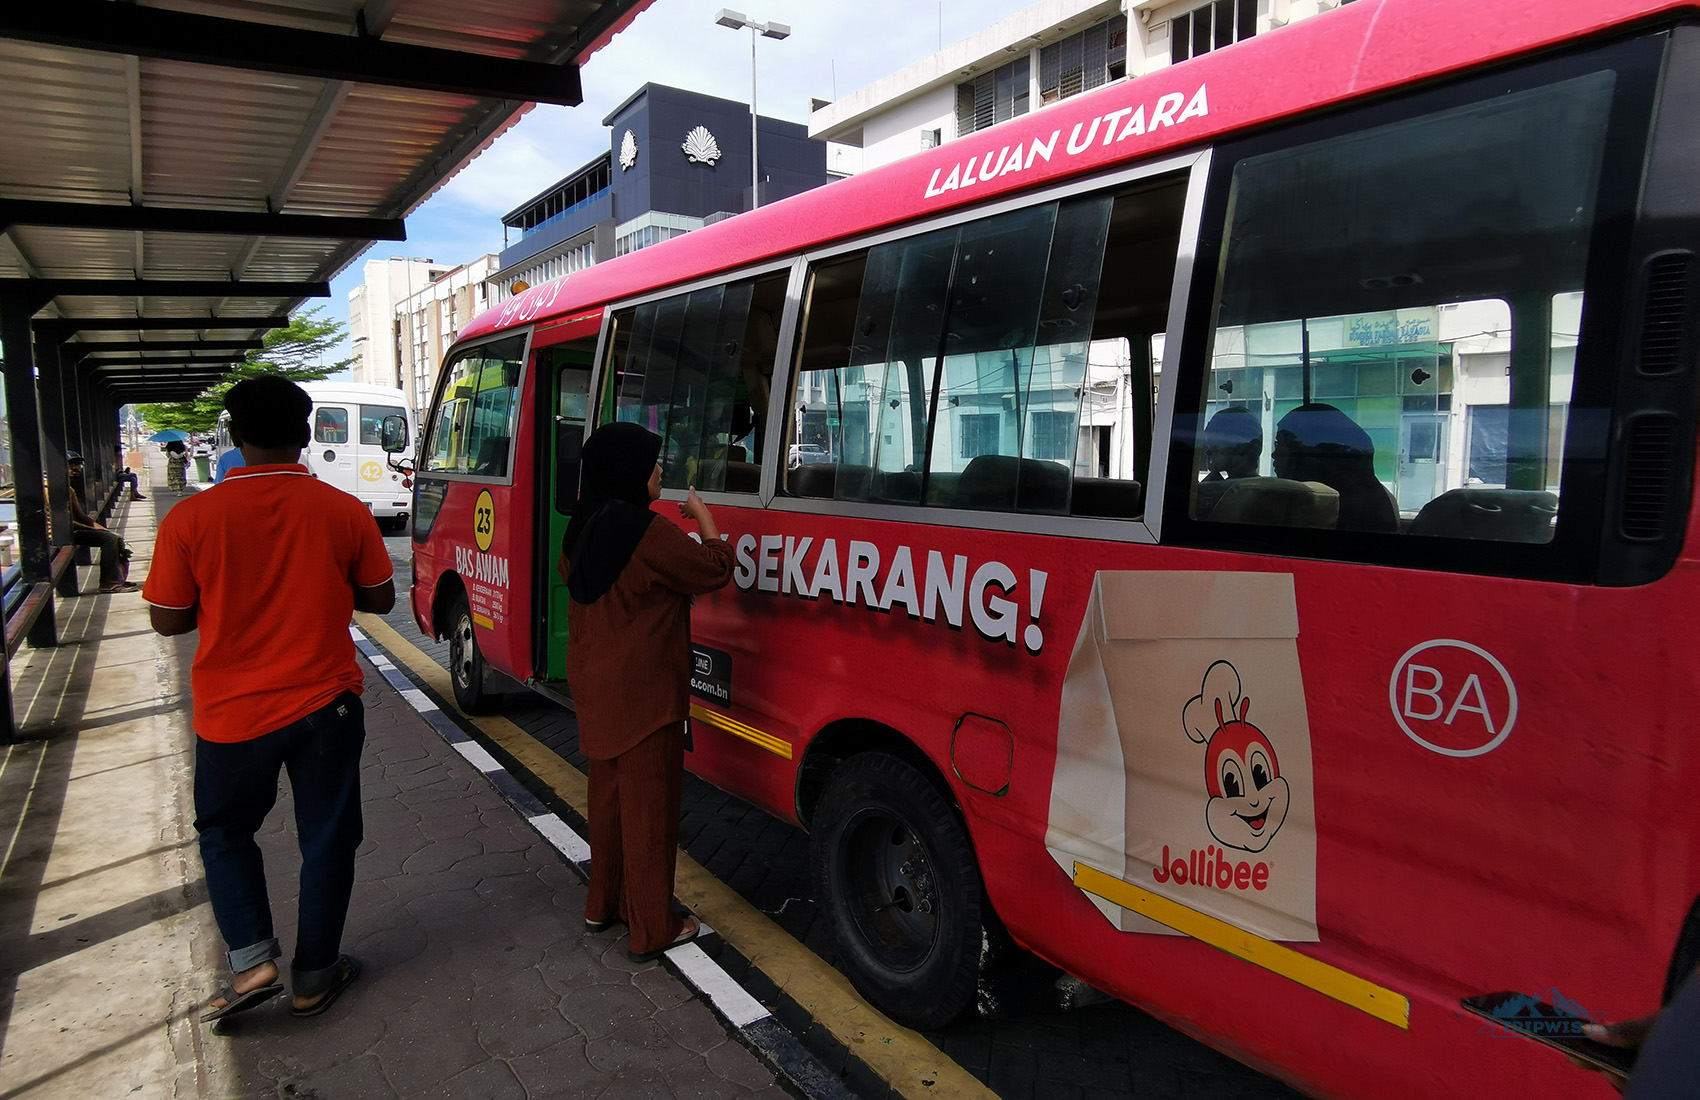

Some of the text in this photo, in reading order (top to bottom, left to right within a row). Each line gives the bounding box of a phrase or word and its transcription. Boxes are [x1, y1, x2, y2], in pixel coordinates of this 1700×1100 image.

[924, 82, 1209, 199] LALUAN UTARA
[362, 465, 380, 479] 42
[477, 507, 491, 534] 23
[455, 546, 509, 589] BAS AWAM
[734, 533, 1049, 655] SEKARANG!
[1403, 664, 1496, 735] BA
[1152, 844, 1270, 892] Jollibee
